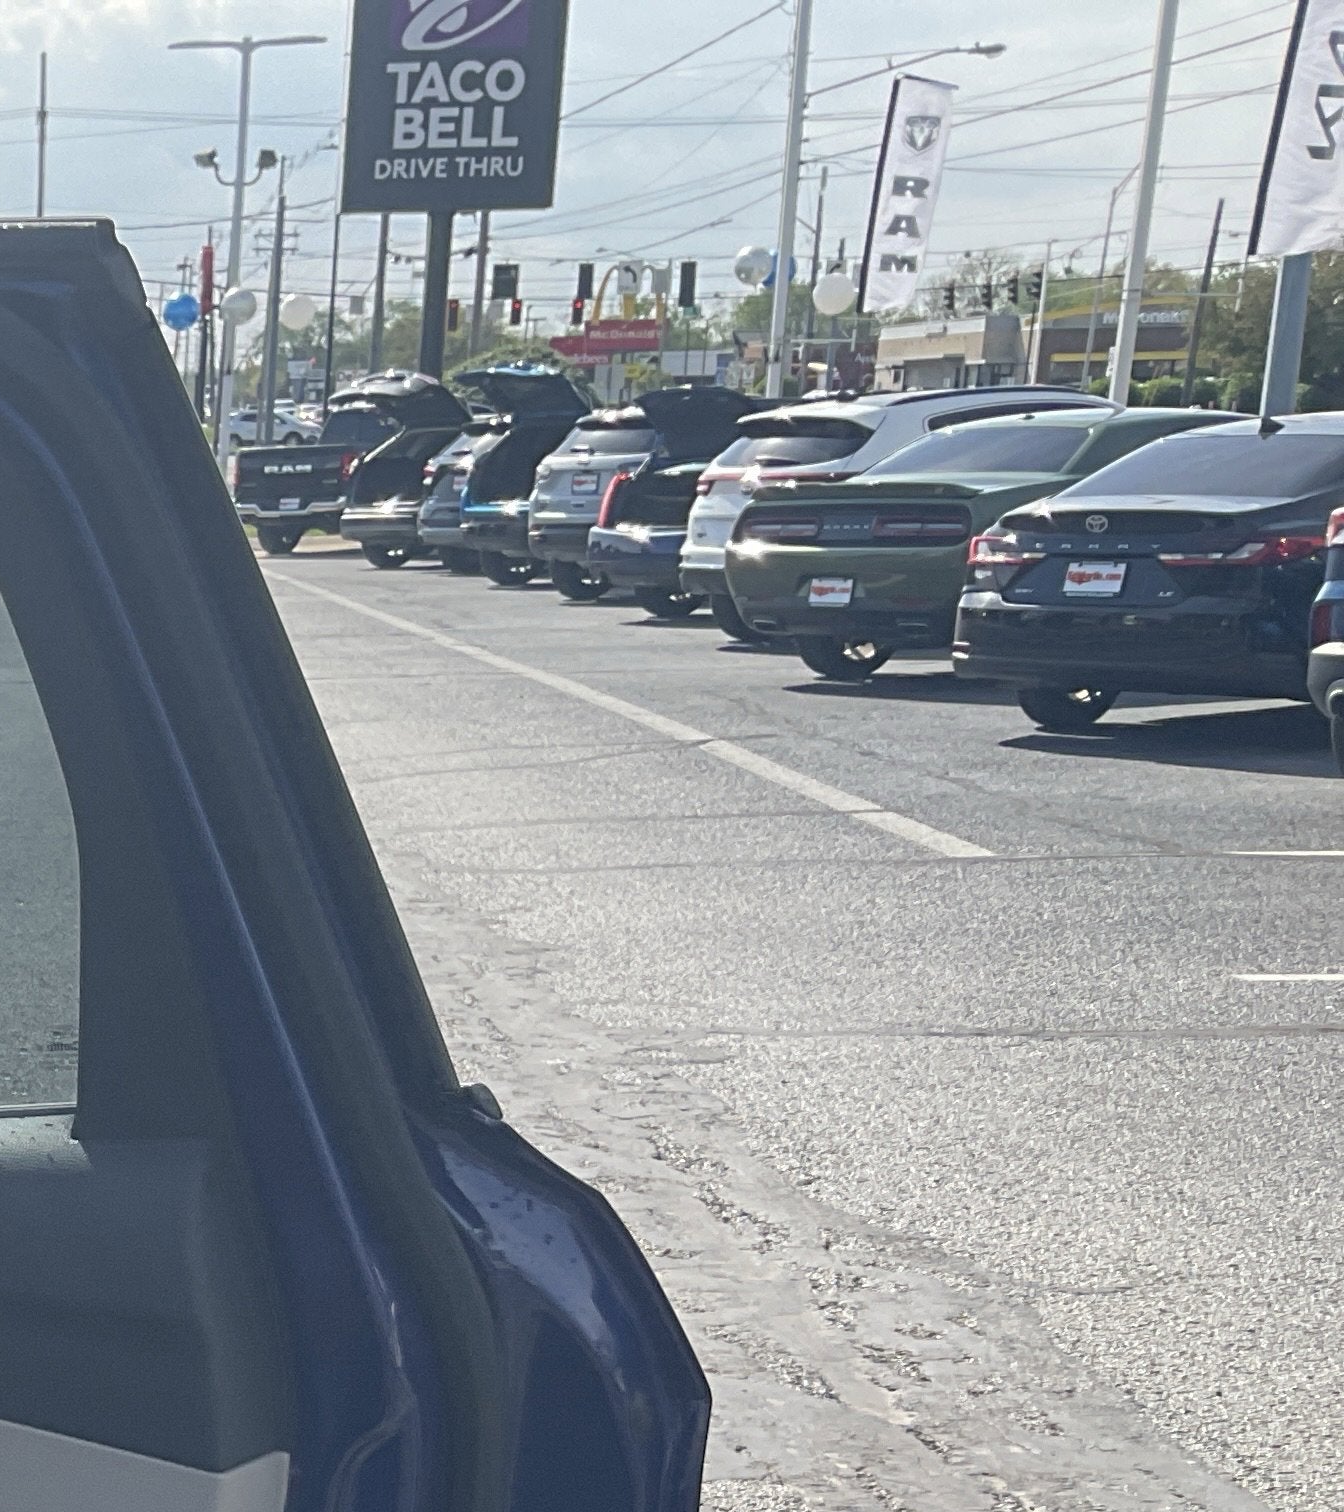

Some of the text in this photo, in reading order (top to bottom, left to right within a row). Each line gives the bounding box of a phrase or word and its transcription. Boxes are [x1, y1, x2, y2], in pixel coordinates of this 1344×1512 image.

[386, 59, 526, 104] TACO
[392, 106, 519, 150] BELL
[374, 156, 524, 180] DRIVE THRU
[878, 175, 930, 274] RAM
[263, 464, 312, 475] RAM
